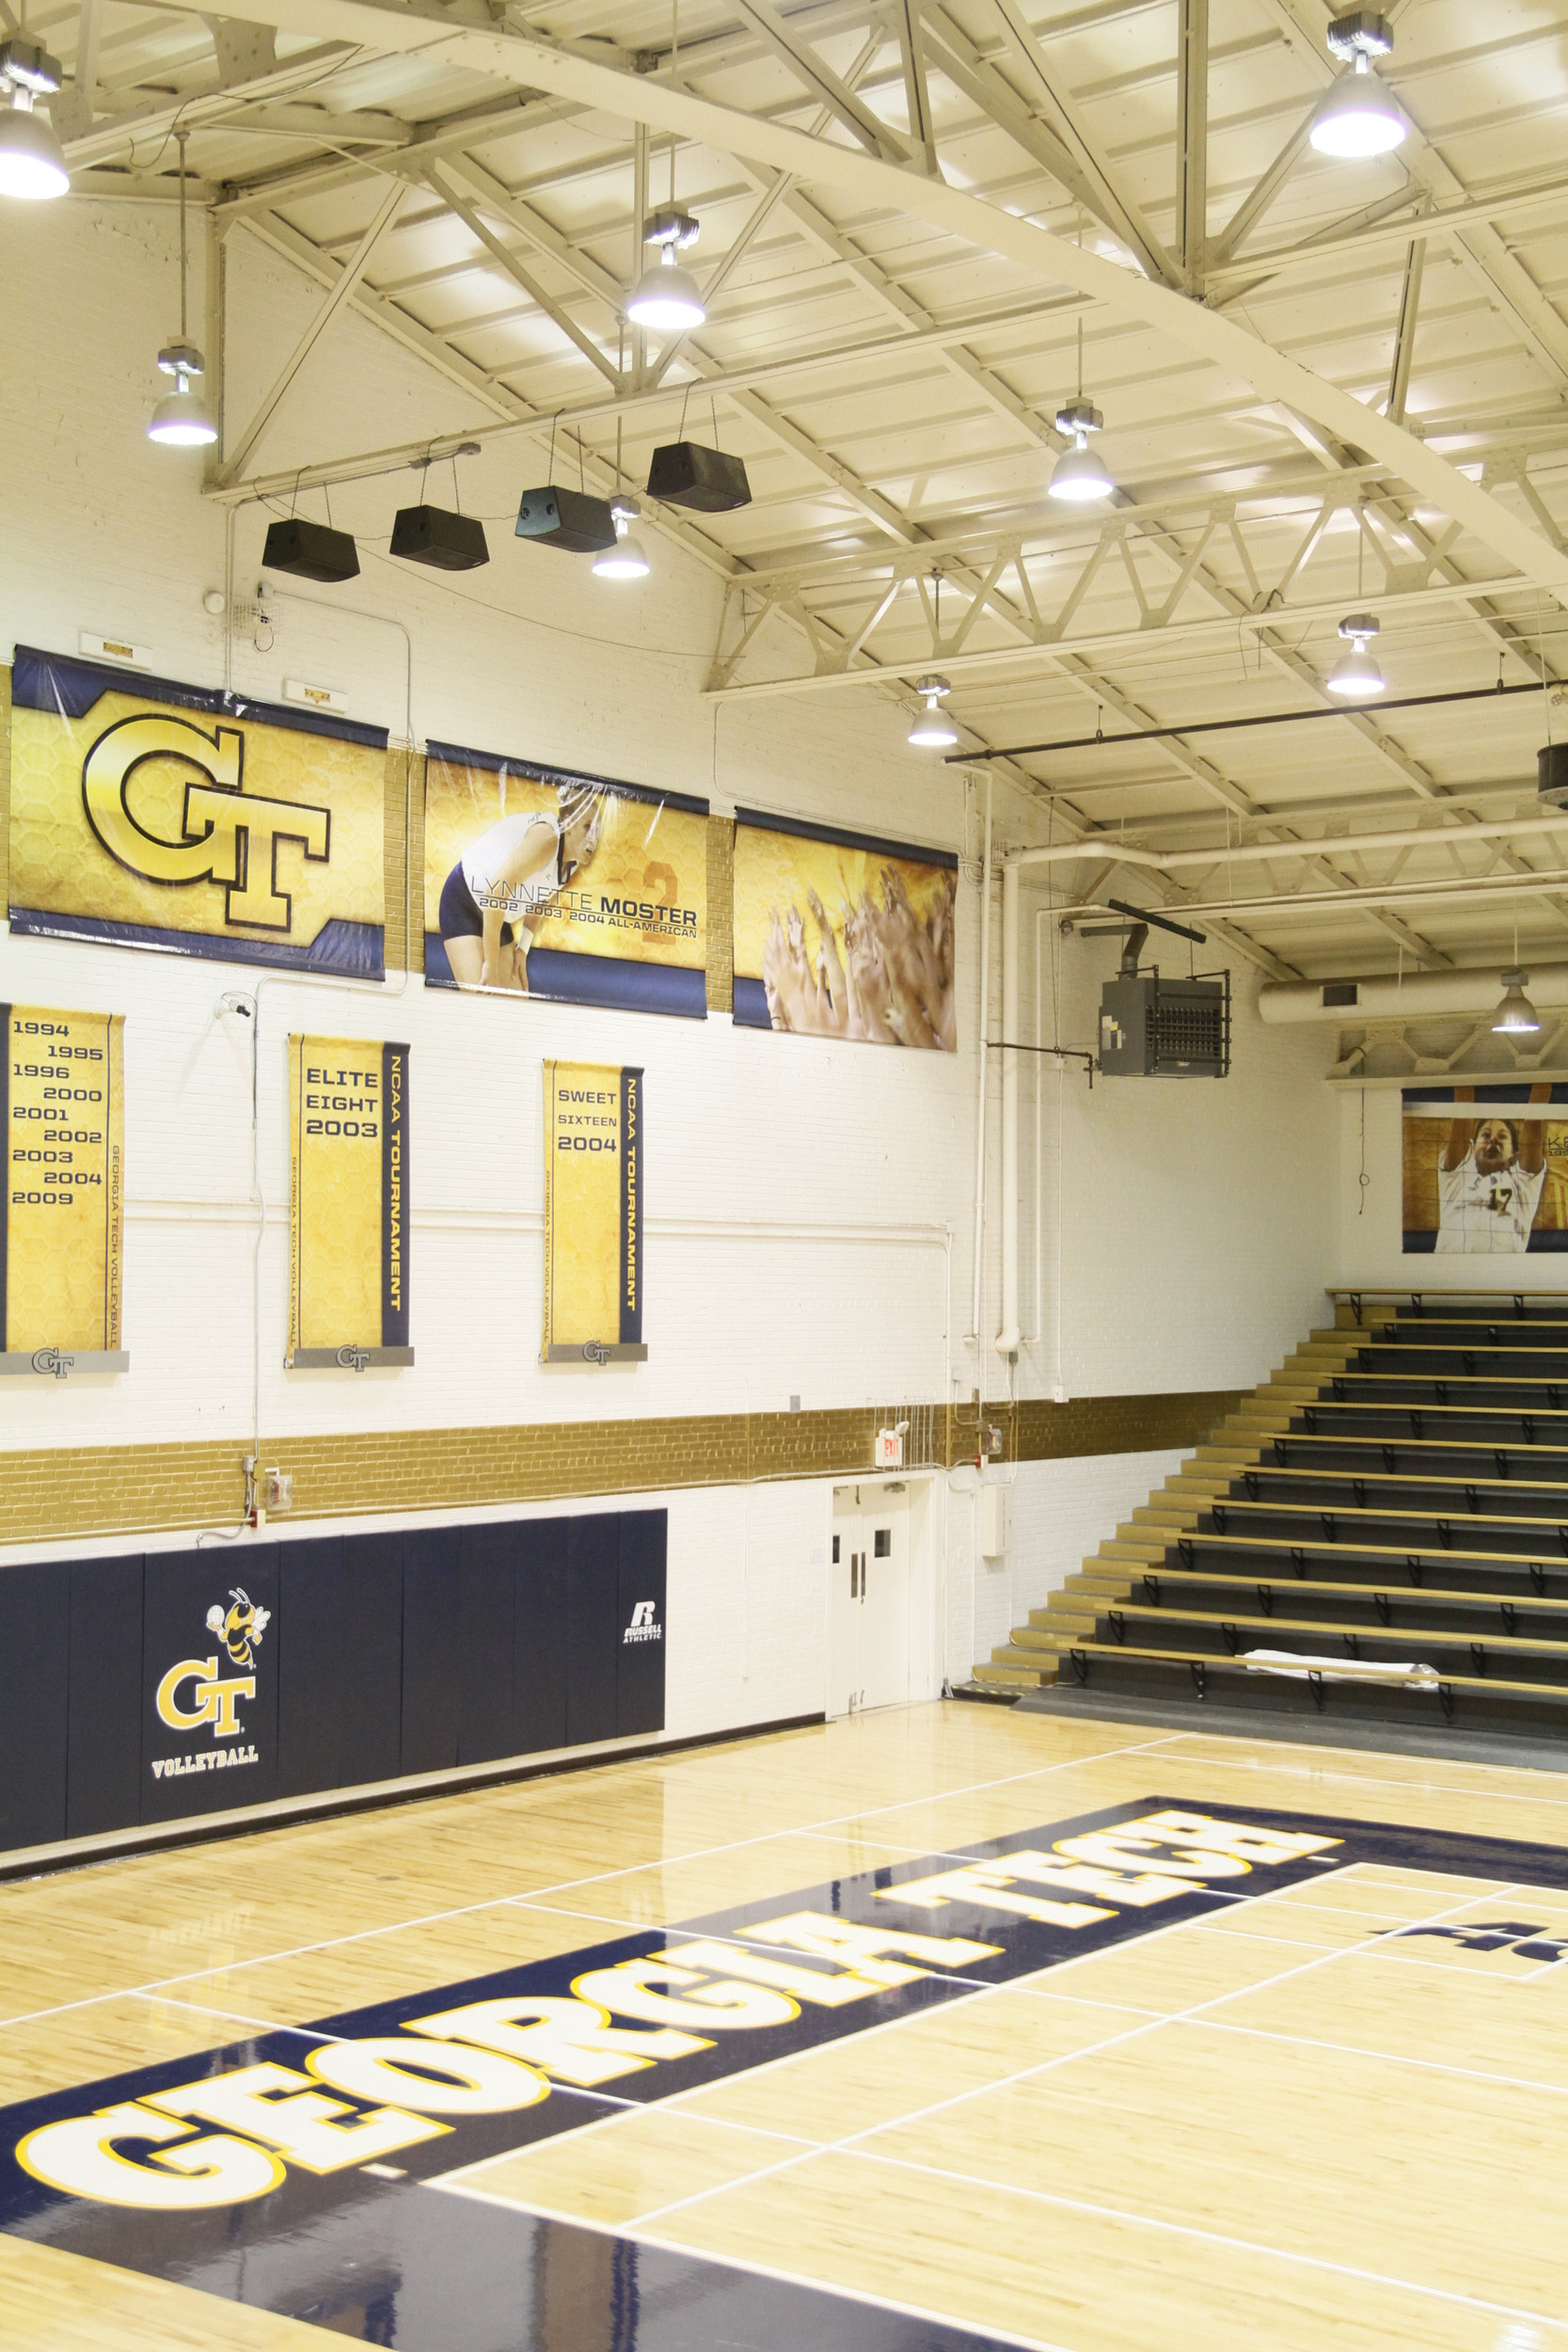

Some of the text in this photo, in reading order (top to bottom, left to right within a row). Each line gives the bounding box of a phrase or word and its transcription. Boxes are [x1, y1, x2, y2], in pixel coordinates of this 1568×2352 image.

[82, 713, 331, 933] GT
[470, 876, 697, 927] LYNNETTE MOSTER
[479, 897, 697, 938] 2002 2003 2004 ALL-AMERICAN
[13, 1021, 70, 1037] 1994
[47, 1045, 103, 1061] 1995
[13, 1064, 70, 1079] 1996
[307, 1068, 378, 1089] ELITE
[43, 1088, 103, 1102] 2000
[306, 1094, 378, 1113] EIGHT
[558, 1089, 617, 1105] SWEET
[13, 1106, 69, 1120] 2001
[558, 1115, 617, 1128] SIXTEEN
[43, 1130, 103, 1144] 2002
[306, 1120, 378, 1137] 2003
[557, 1136, 617, 1152] 2004
[12, 1150, 73, 1164] 2003
[43, 1172, 103, 1185] 2004
[389, 1056, 402, 1311] NCAA TOURNAMENT
[12, 1192, 73, 1205] 2009
[626, 1078, 637, 1311] NCAA TOURNAMENT
[1489, 1187, 1513, 1214] 17
[109, 1145, 119, 1348] GEORGIA TECH VOLLEYBALL
[336, 1344, 370, 1373] GT
[582, 1340, 611, 1366] GT
[32, 1348, 74, 1379] GT
[884, 1438, 899, 1458] EXIT
[623, 1632, 661, 1644] ATHLETIC
[624, 1624, 661, 1638] RUSSELL
[156, 1656, 256, 1738] GT
[151, 1745, 259, 1779] VOLLEYBALL
[14, 1808, 1346, 2209] GEORGIA TECH
